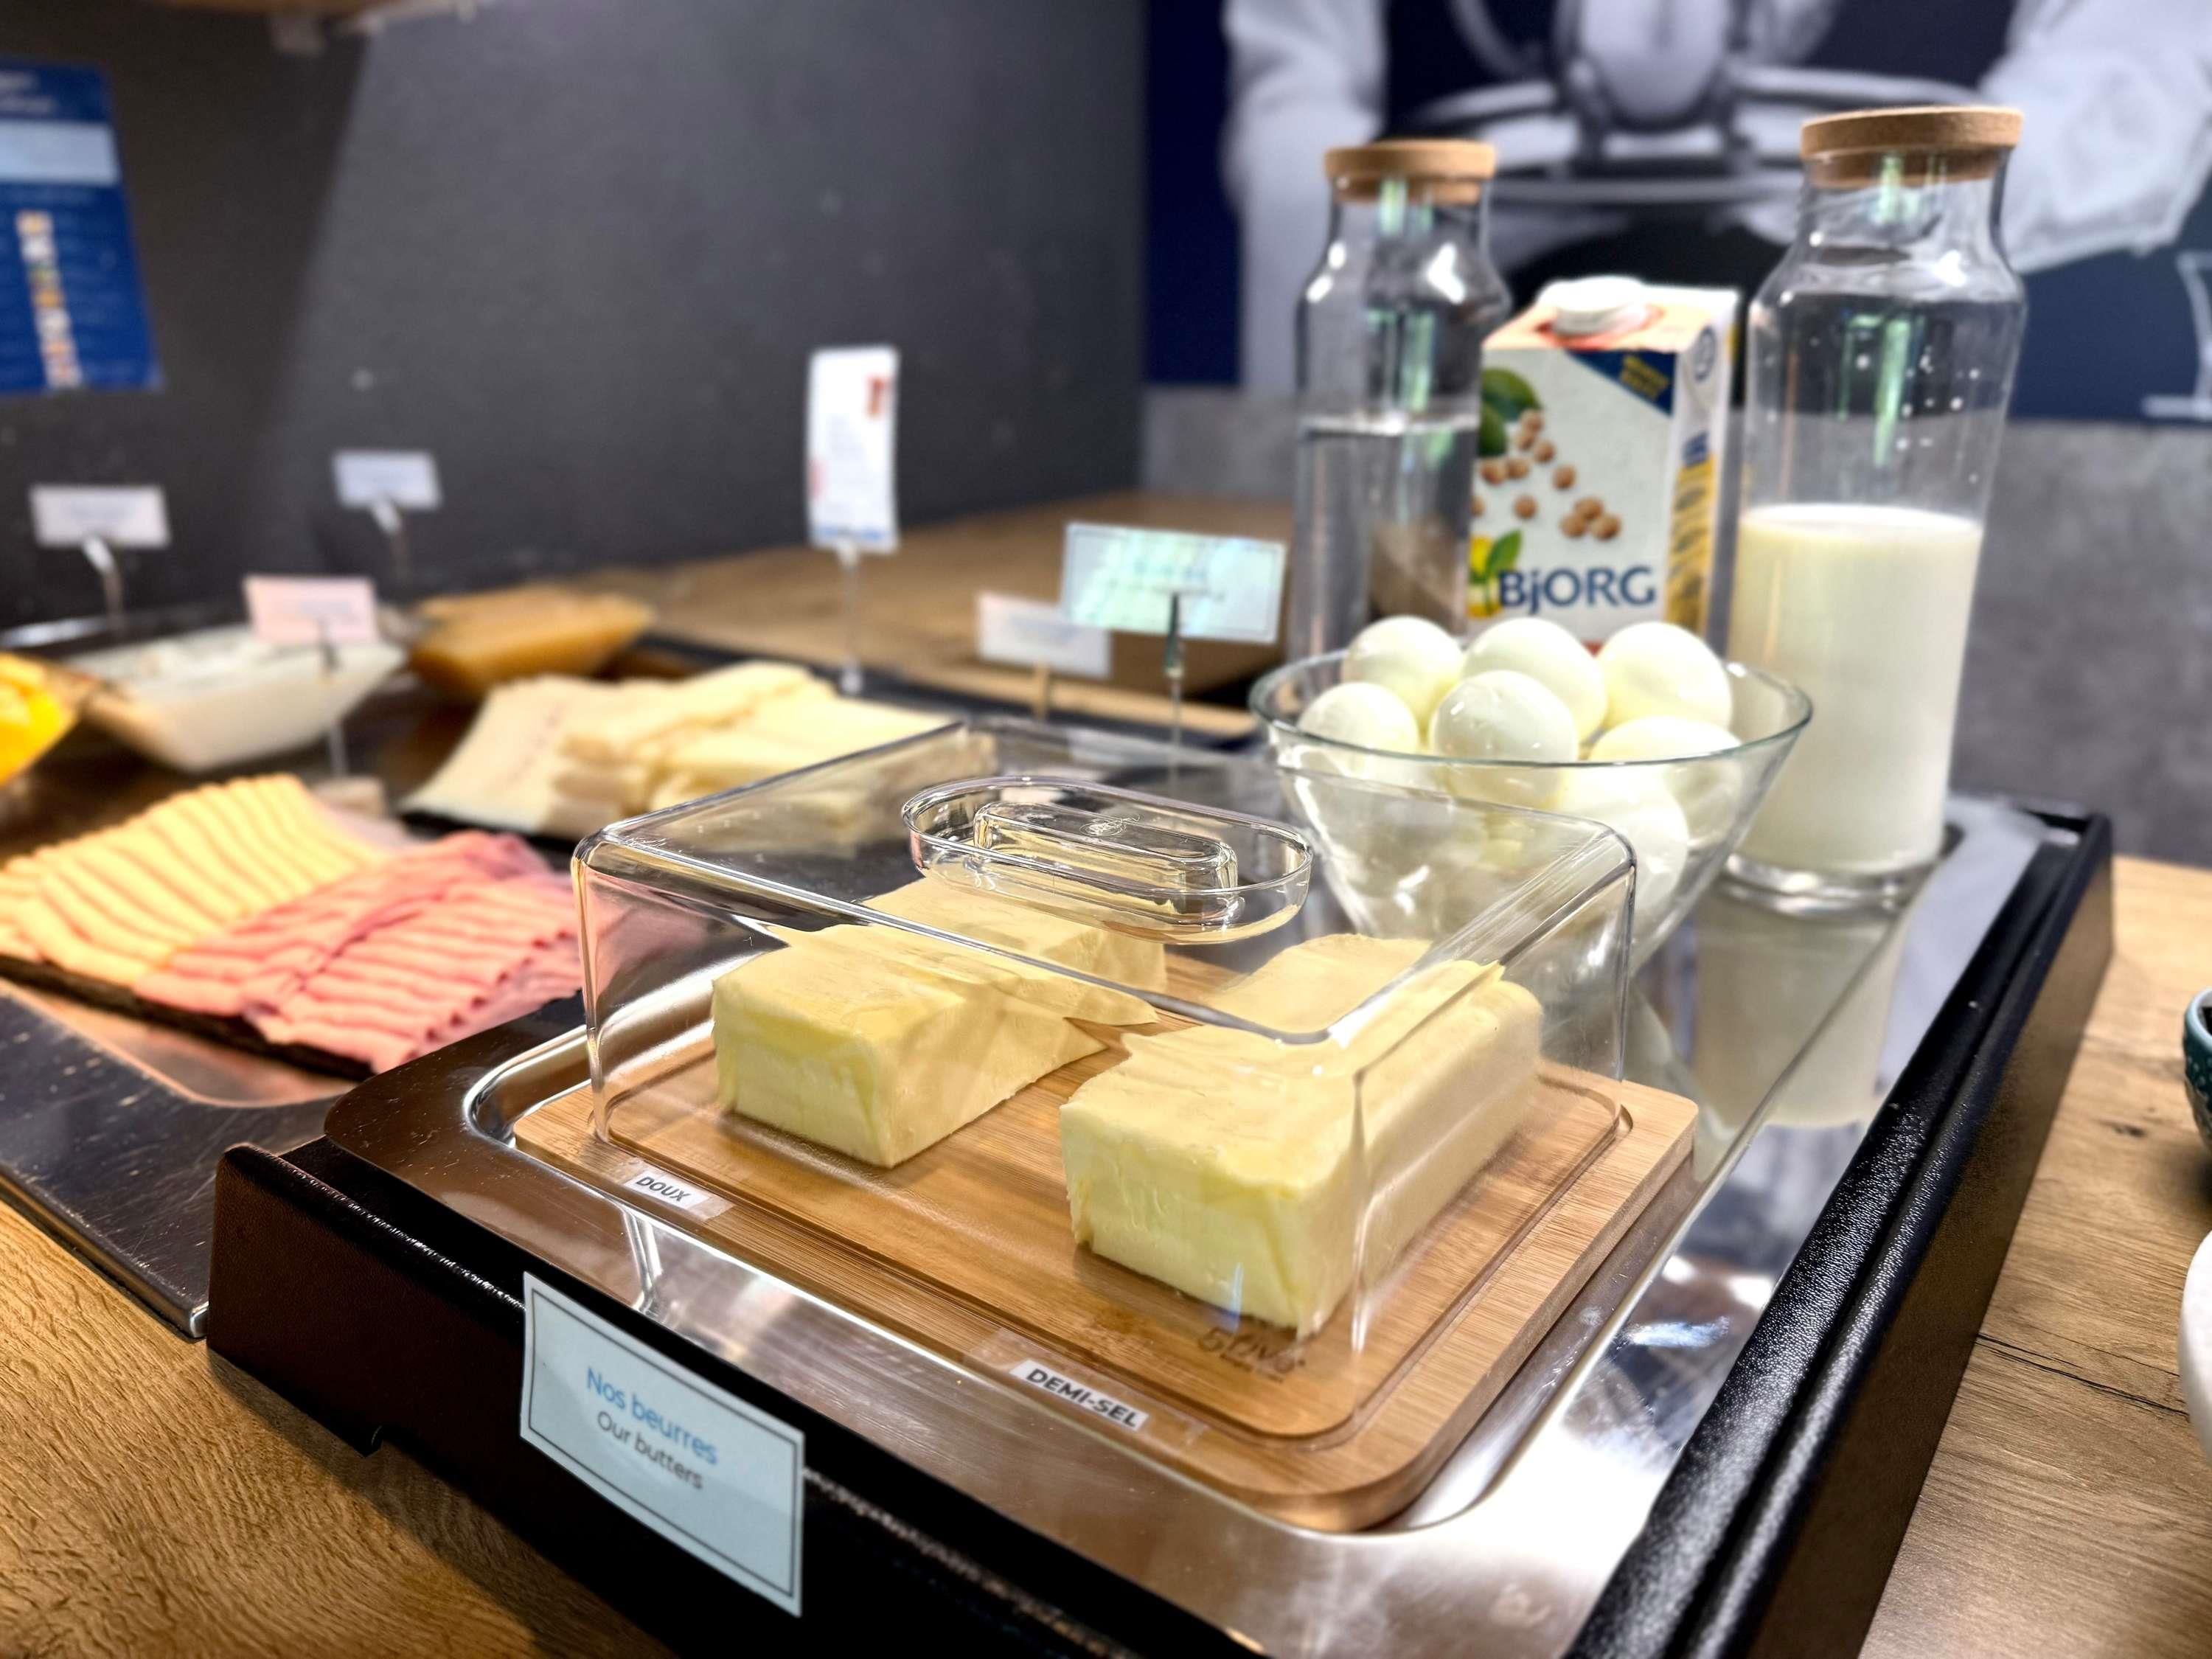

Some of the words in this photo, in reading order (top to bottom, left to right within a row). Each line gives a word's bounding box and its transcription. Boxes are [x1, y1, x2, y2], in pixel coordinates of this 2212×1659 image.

[1499, 566, 1656, 615] BjORG
[636, 1176, 691, 1202] DOUX
[587, 1367, 626, 1410] Nos
[633, 1393, 718, 1465] beurres
[1026, 1368, 1138, 1427] DEMI-SEL
[597, 1411, 631, 1443] Our
[635, 1432, 703, 1489] butters
